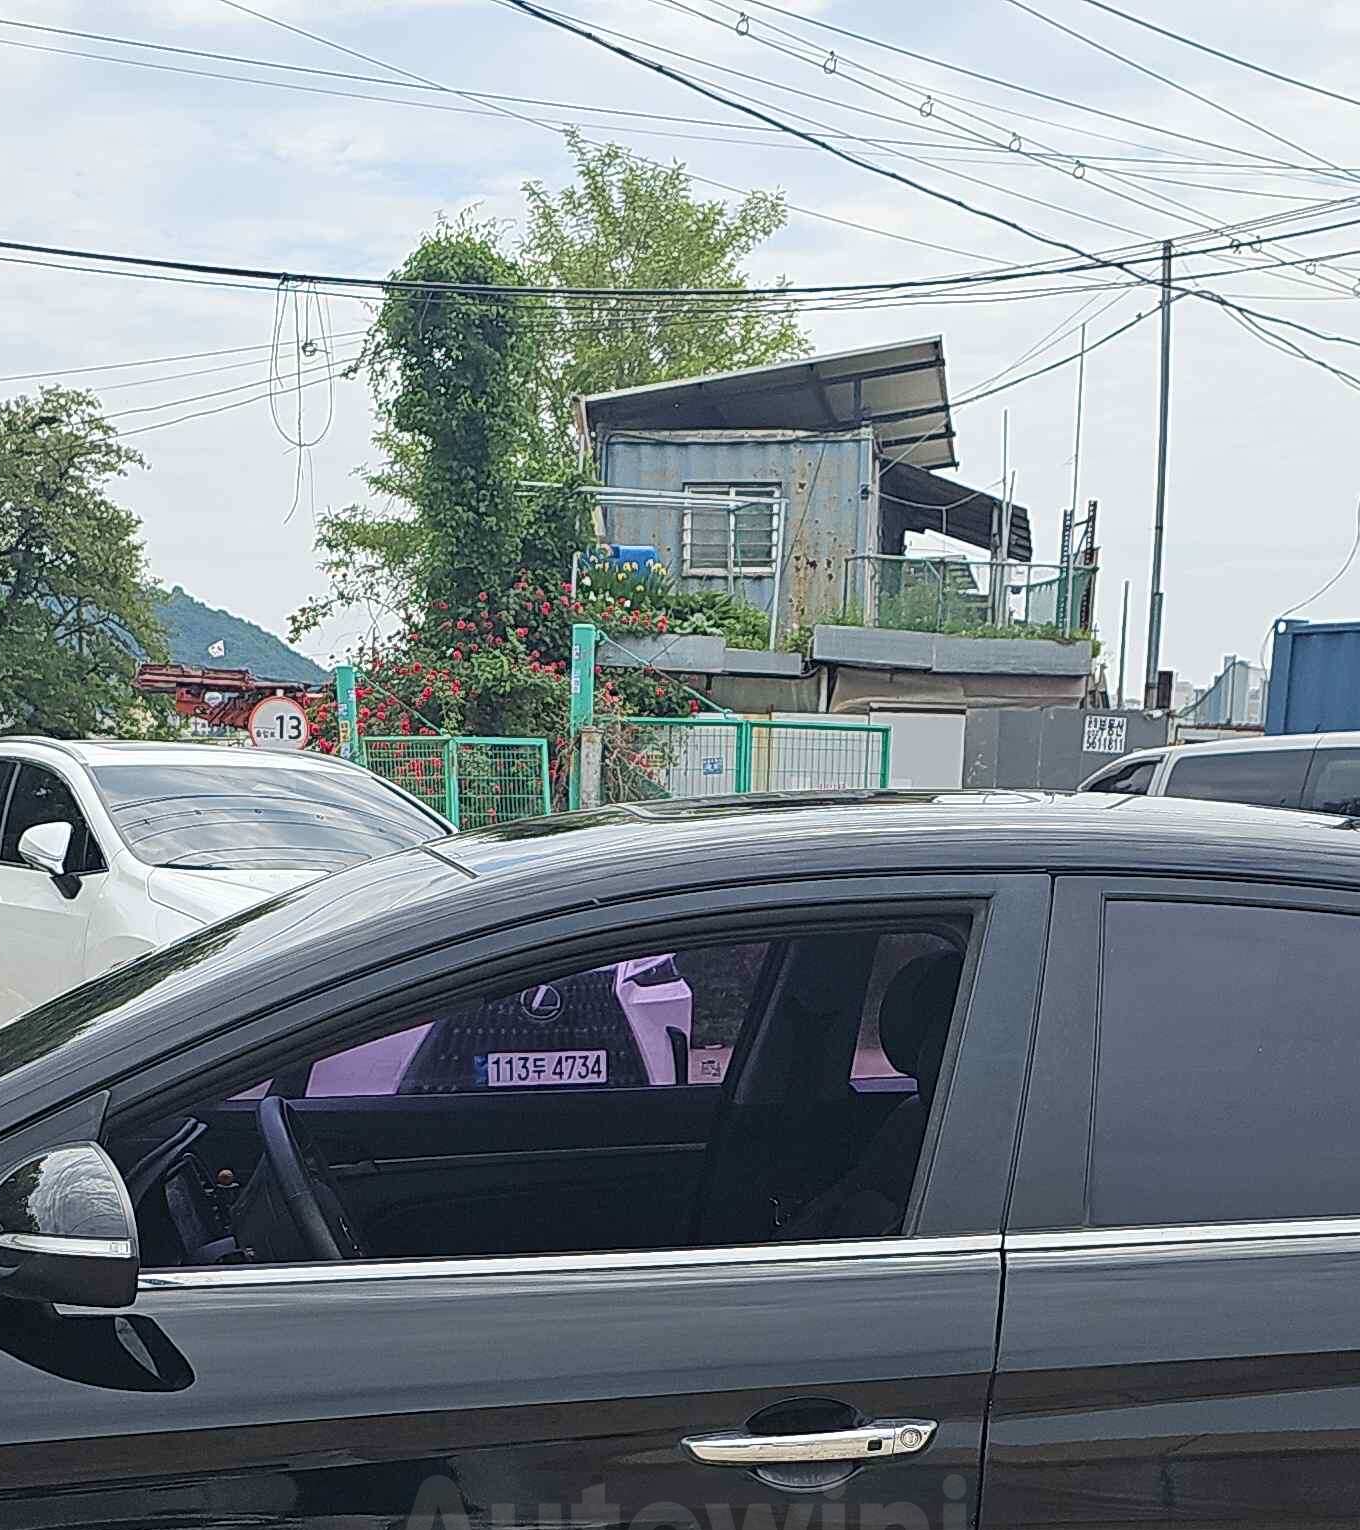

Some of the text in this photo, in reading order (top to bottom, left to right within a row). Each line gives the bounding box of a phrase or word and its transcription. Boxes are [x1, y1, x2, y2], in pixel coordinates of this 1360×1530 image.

[275, 714, 302, 740] 13
[492, 1055, 602, 1082] 113두 4734
